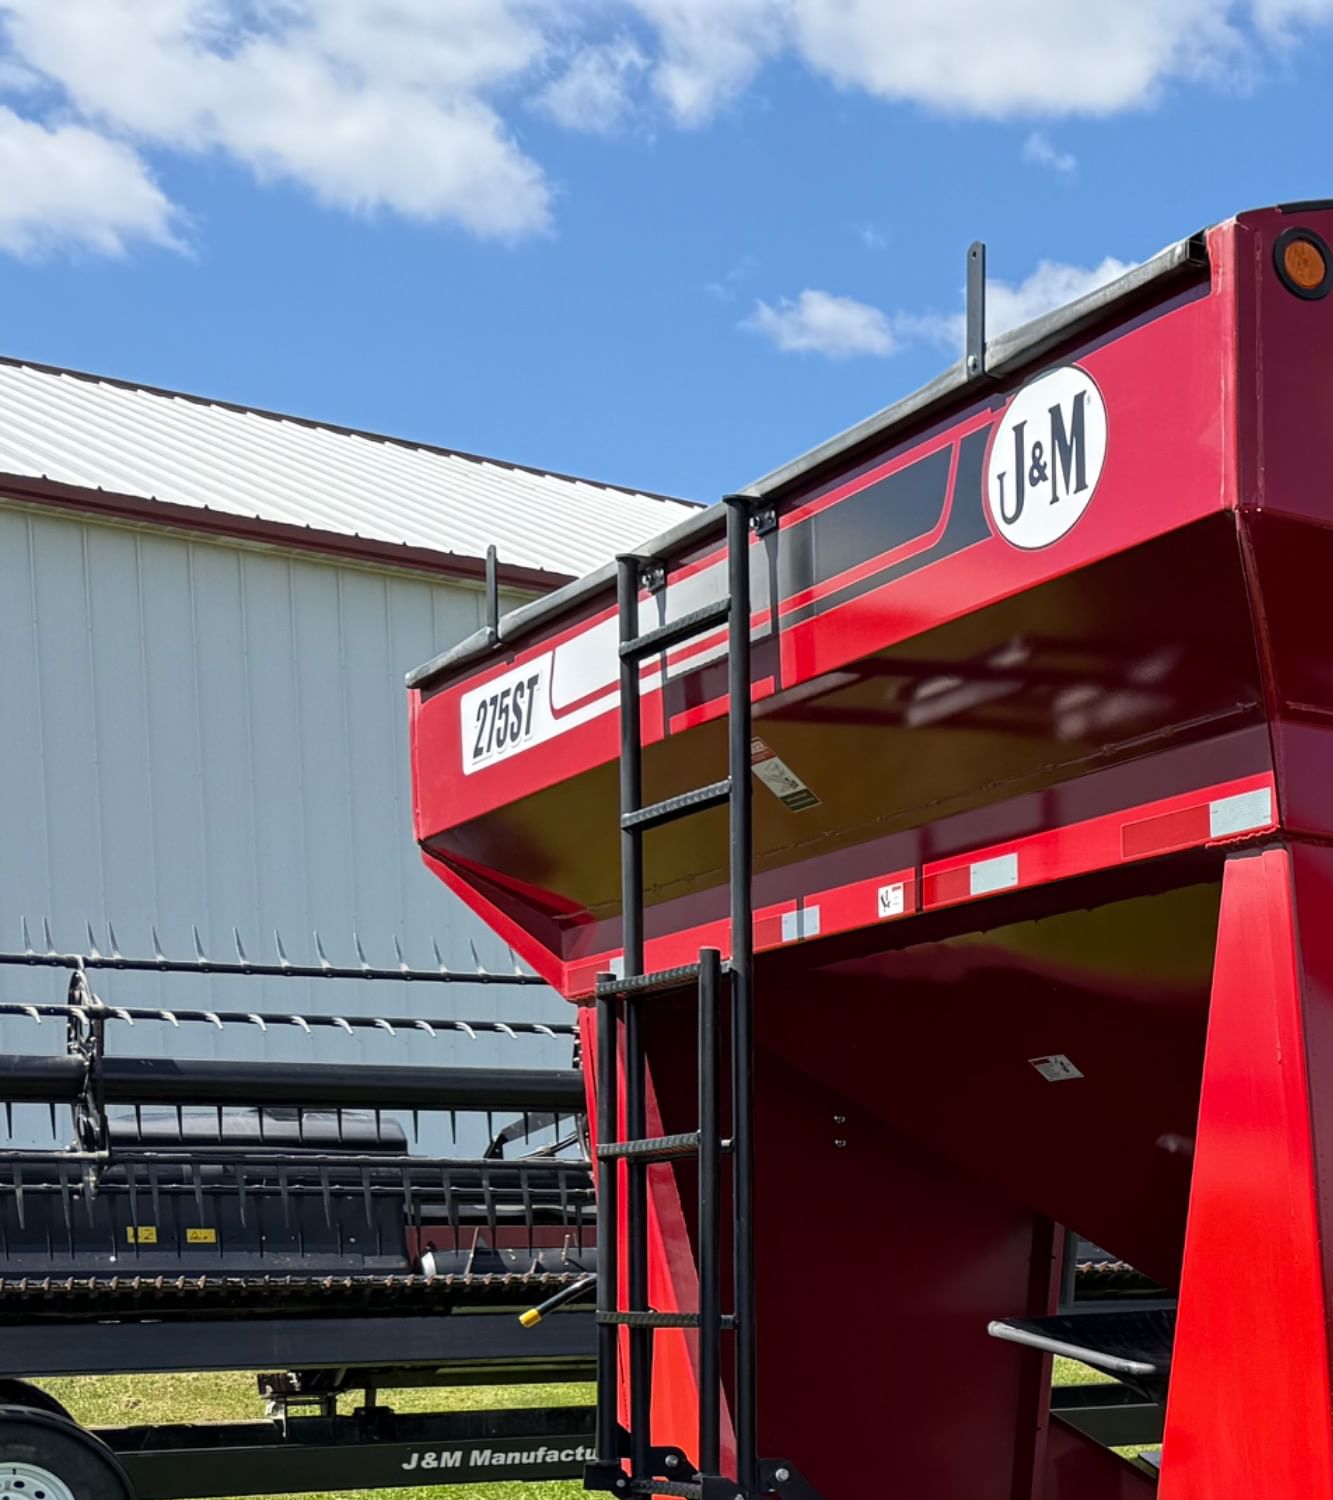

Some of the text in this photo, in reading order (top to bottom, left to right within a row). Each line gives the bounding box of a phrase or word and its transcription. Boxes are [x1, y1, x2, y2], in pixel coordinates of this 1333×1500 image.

[997, 389, 1088, 525] J&M
[473, 674, 539, 759] 275ST
[402, 1446, 598, 1470] J&M Manufactu
